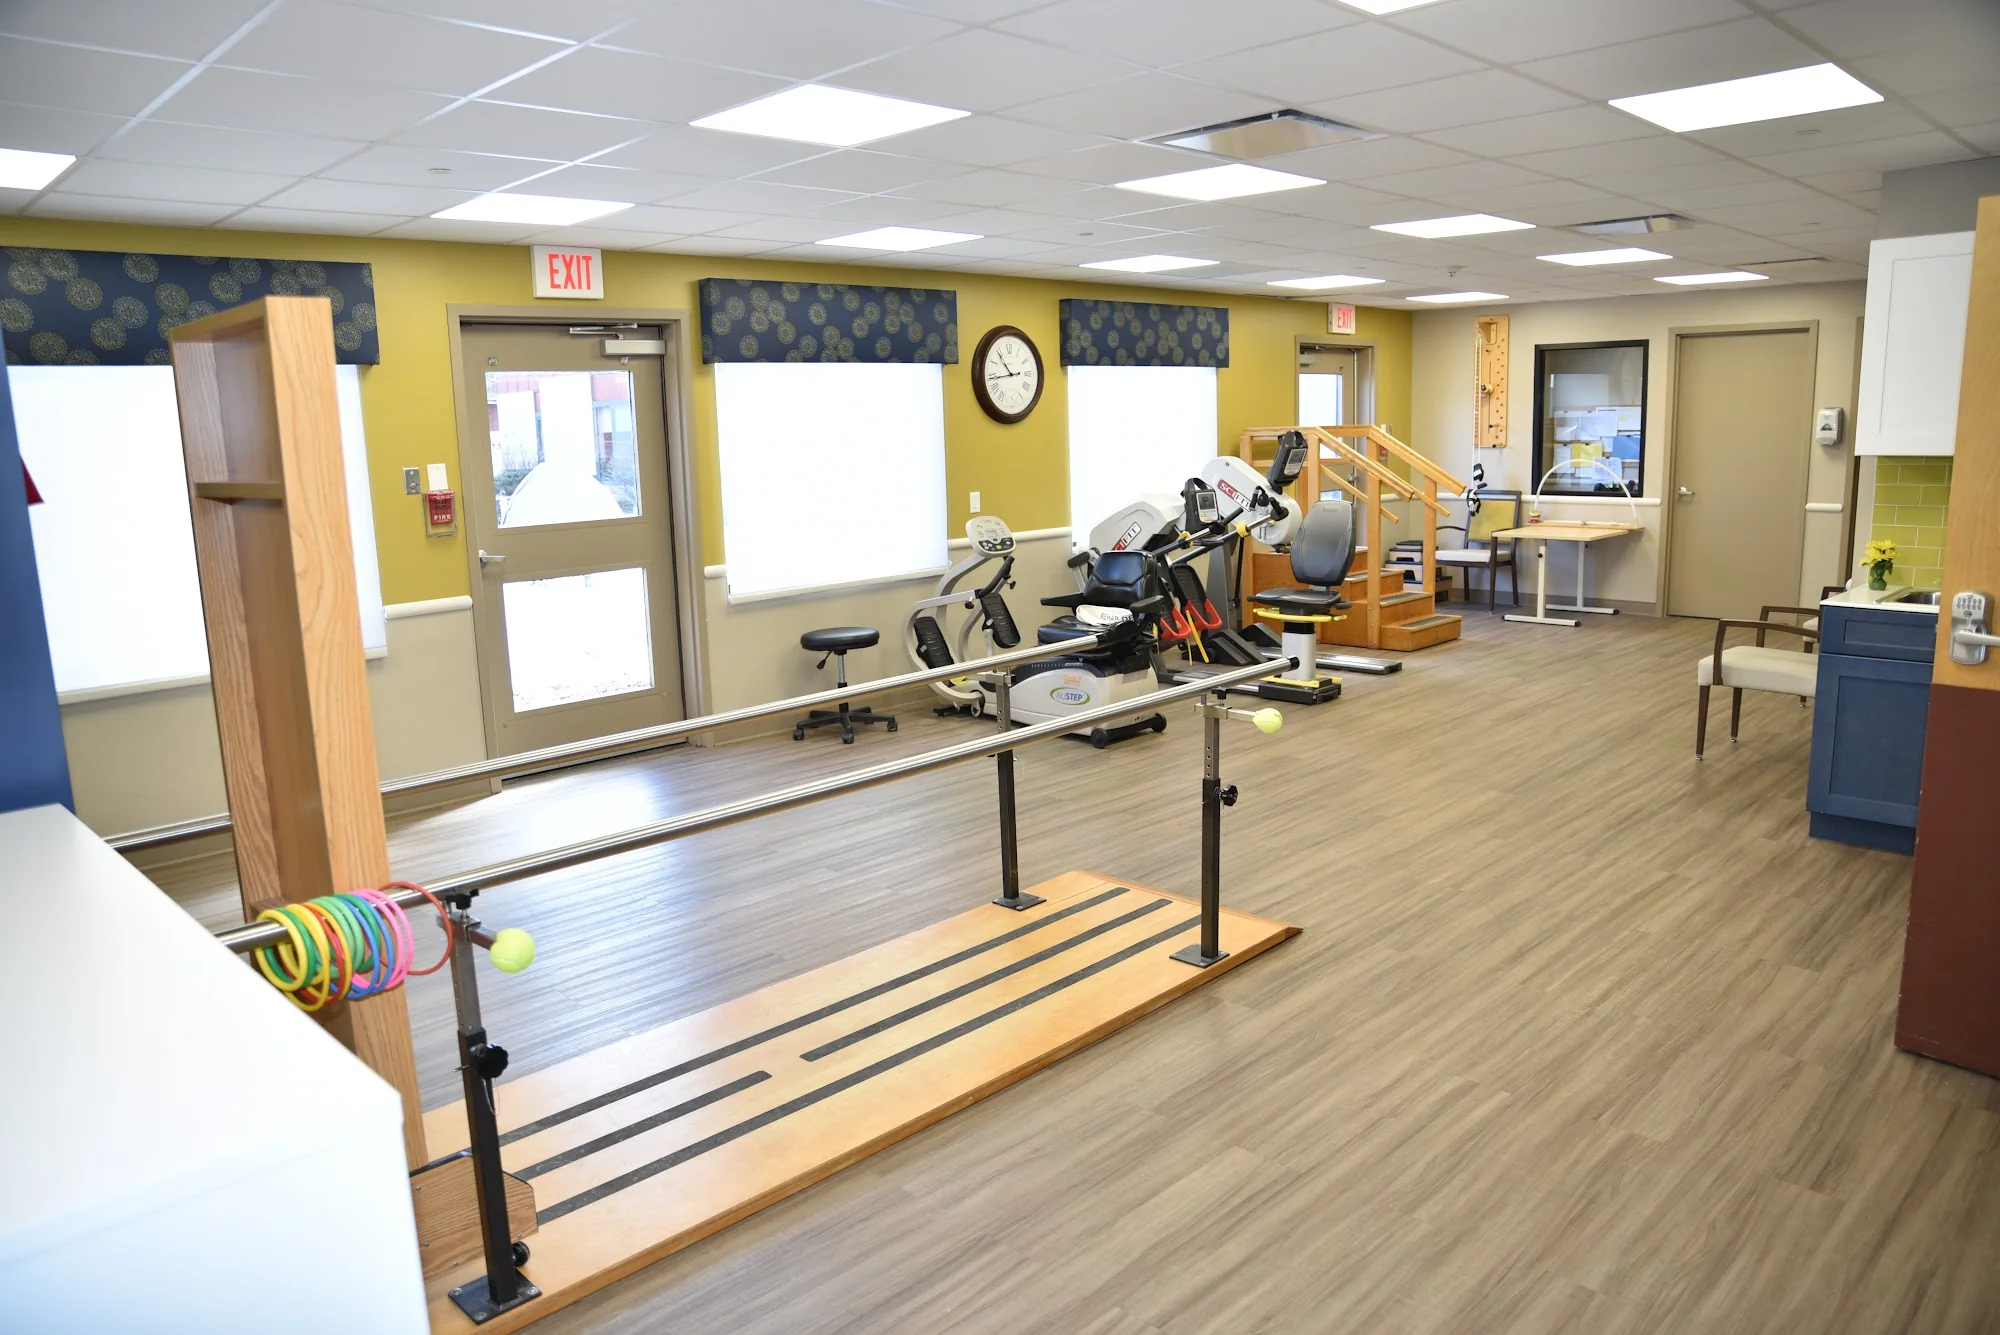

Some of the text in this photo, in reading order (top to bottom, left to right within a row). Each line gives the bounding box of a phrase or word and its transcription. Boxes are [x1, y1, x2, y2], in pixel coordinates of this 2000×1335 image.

[548, 253, 592, 290] EXIT
[1337, 308, 1352, 329] EXIT
[1219, 482, 1250, 508] SCIFIT
